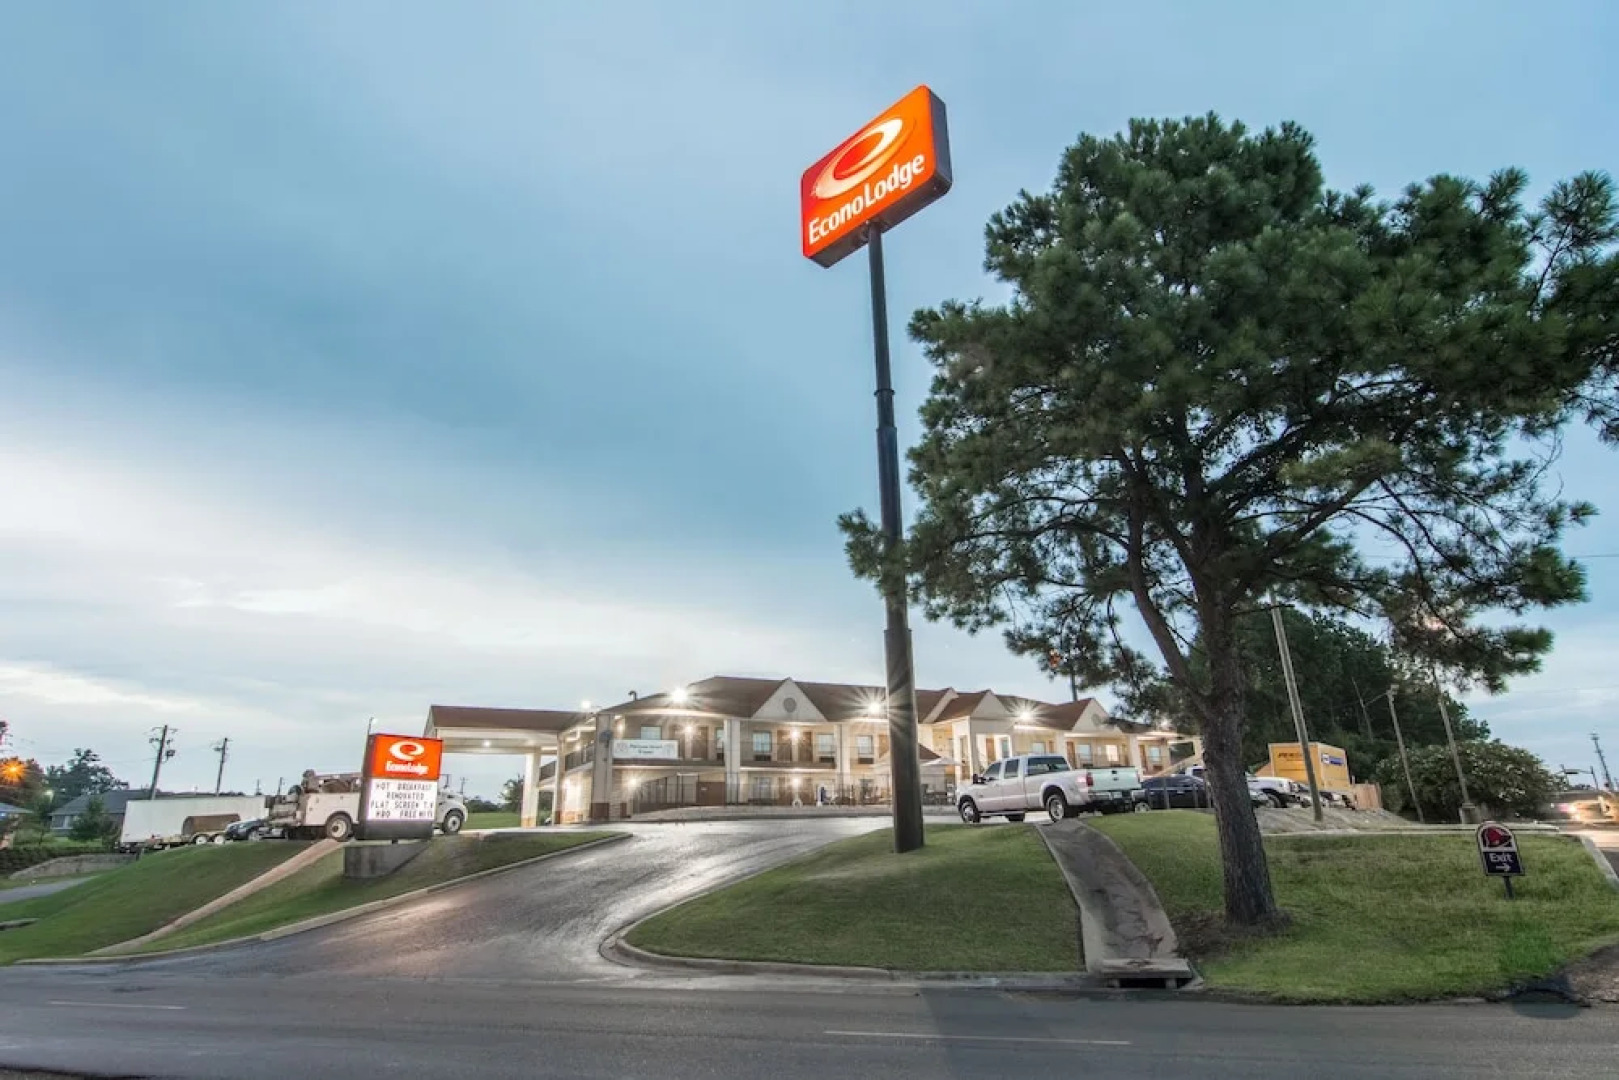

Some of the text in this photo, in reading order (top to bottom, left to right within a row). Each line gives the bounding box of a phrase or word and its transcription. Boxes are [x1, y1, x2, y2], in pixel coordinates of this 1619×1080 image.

[386, 792, 425, 800] RENOVATED
[371, 800, 390, 809] FLAT
[395, 801, 420, 809] SCREEN
[400, 810, 417, 818] FREE
[1489, 852, 1513, 863] Exit
